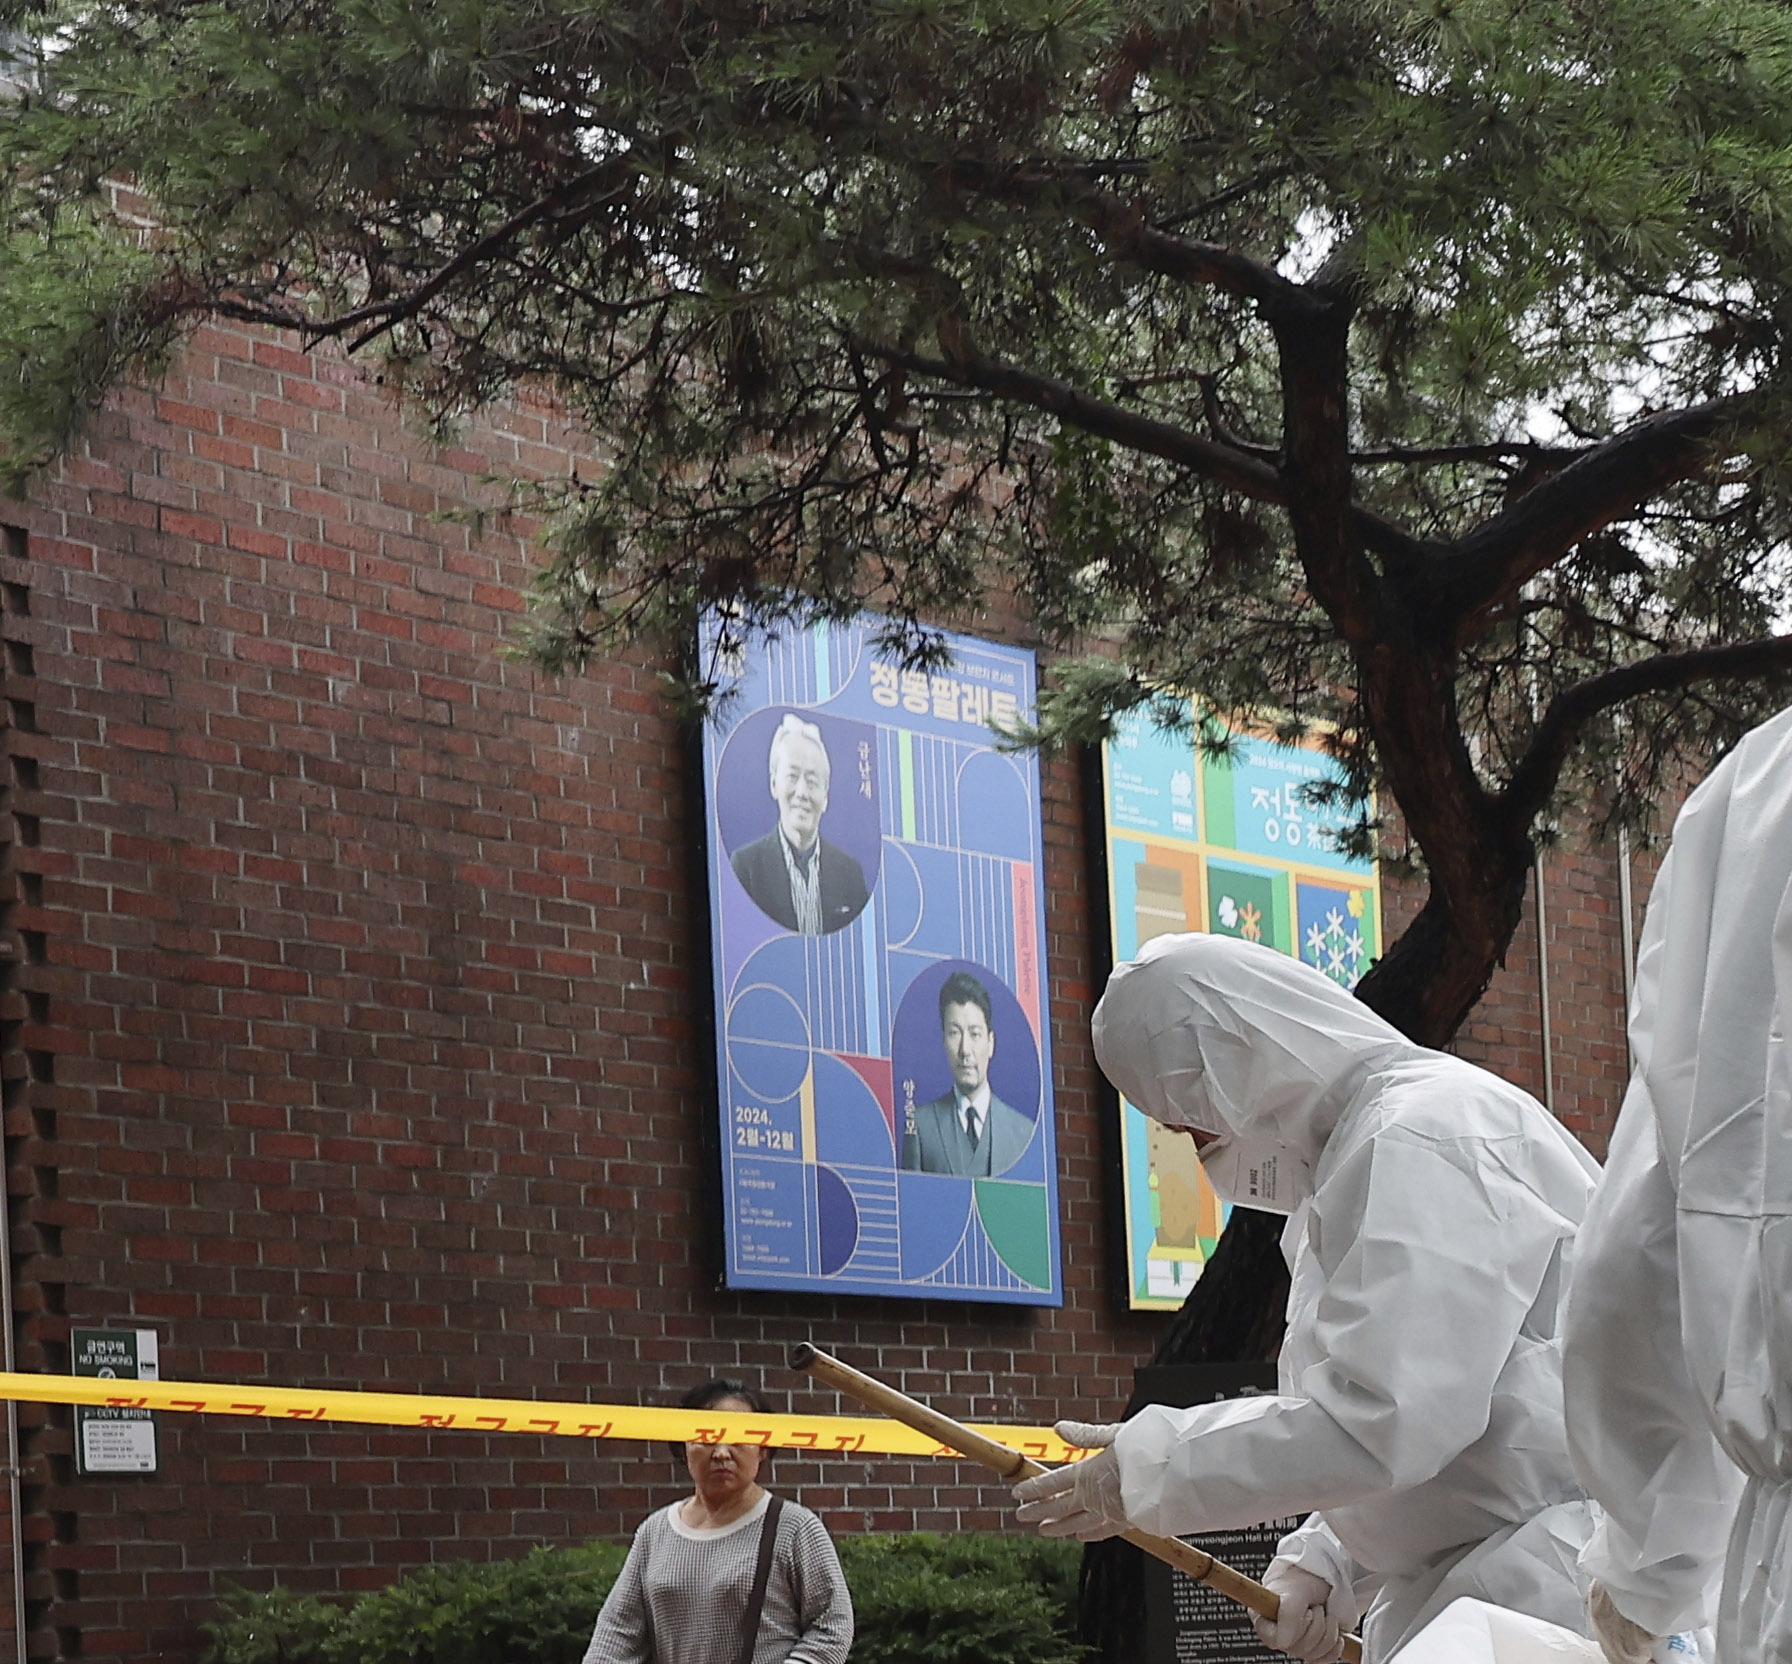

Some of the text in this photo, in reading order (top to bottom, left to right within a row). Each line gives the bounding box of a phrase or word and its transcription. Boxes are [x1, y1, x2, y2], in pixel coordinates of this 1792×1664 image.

[86, 1340, 125, 1354] 금연구역
[79, 1354, 133, 1366] NO SMOKING
